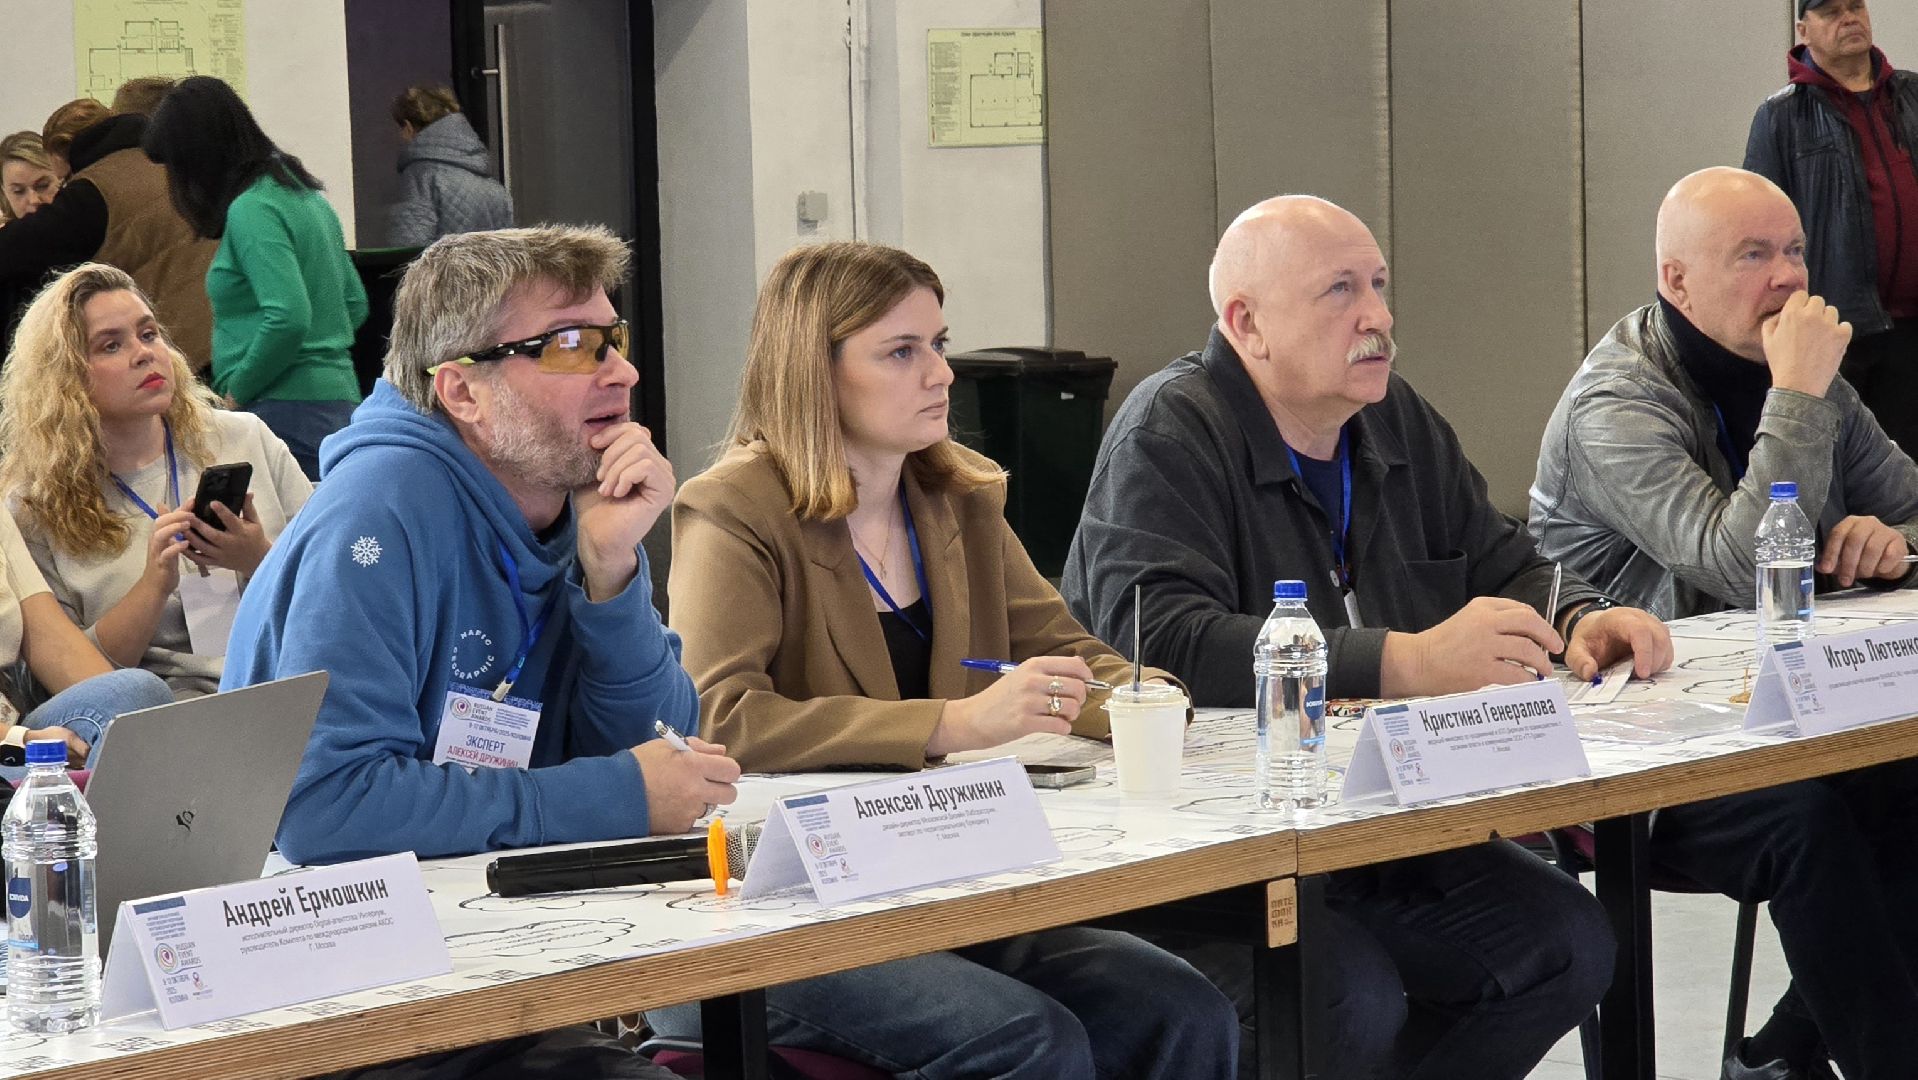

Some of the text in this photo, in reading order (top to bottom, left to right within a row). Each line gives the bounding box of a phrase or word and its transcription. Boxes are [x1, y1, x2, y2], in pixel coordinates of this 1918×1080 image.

[1823, 645, 1866, 672] Игорь
[1419, 709, 1483, 736] Кристина
[1482, 698, 1557, 725] Генералова
[447, 745, 479, 761] АЛЕКСЕЙ
[466, 734, 506, 753] ЭКСПЕРТ
[853, 785, 924, 819] Алексей
[922, 779, 1007, 812] Дружинин
[222, 887, 295, 927] Андрей
[295, 878, 389, 918] Ермошкин
